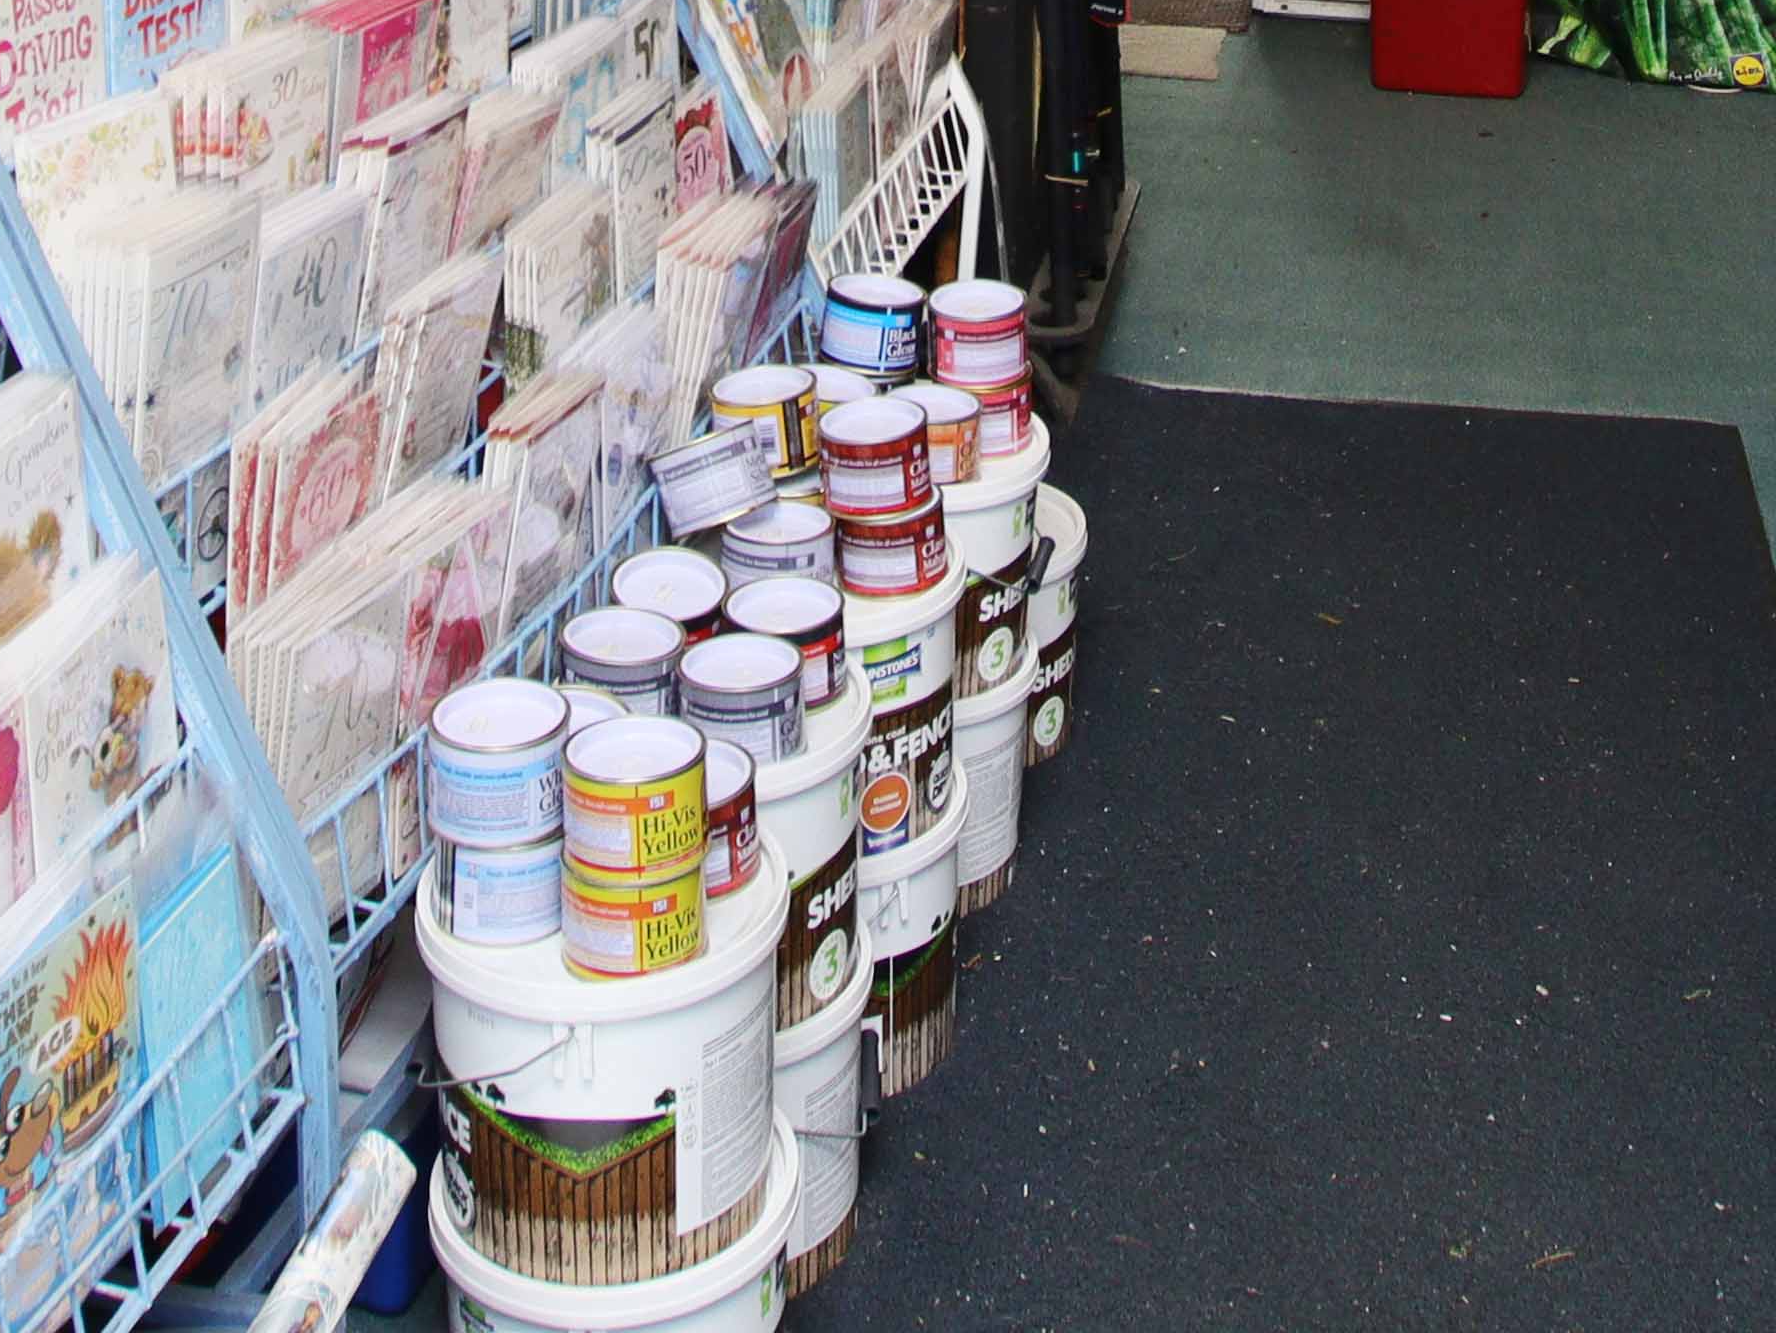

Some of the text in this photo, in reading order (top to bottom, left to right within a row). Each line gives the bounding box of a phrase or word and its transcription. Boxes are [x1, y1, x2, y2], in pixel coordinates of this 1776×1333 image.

[988, 641, 1004, 670] 3
[1044, 710, 1057, 736] 3
[640, 802, 698, 838] Hi-Vis
[640, 823, 702, 857] Yellow
[644, 905, 699, 939] Hi-Vis
[644, 926, 702, 962] Yellow
[34, 1017, 75, 1063] AGE
